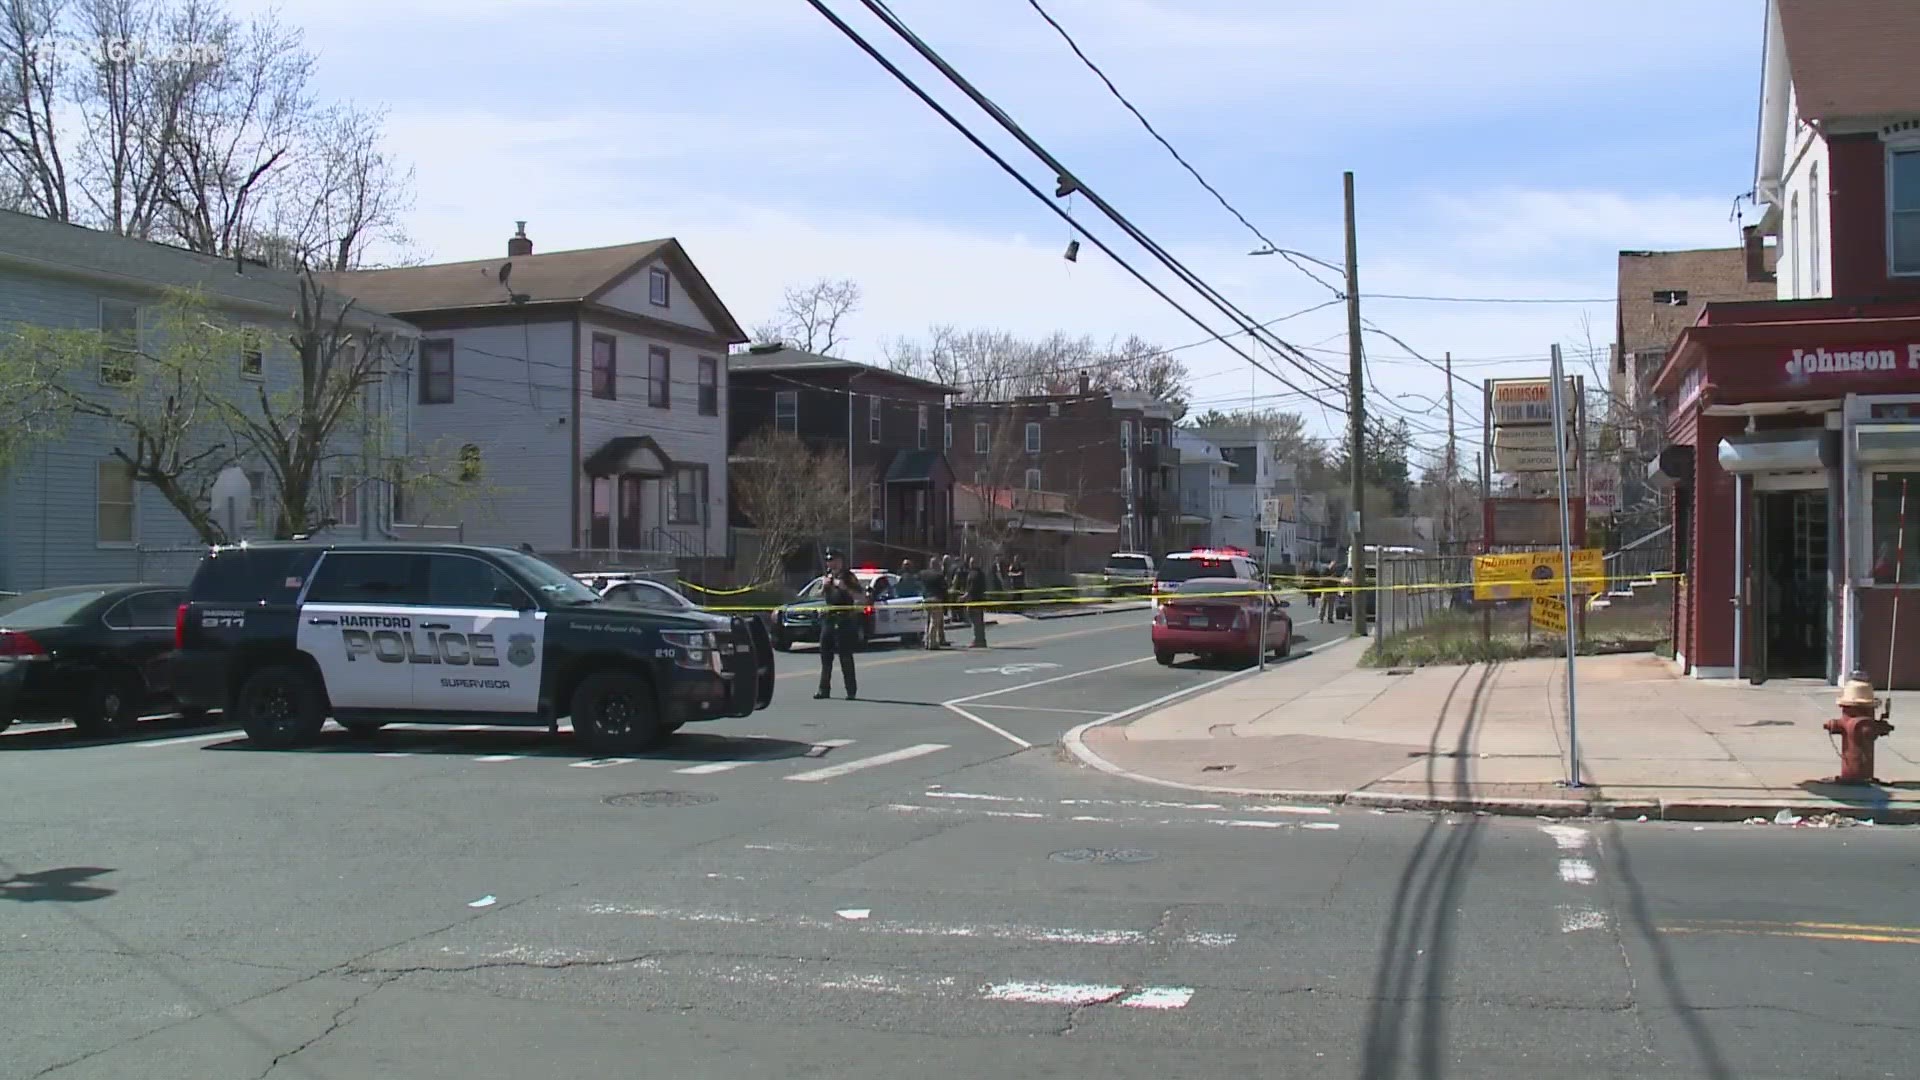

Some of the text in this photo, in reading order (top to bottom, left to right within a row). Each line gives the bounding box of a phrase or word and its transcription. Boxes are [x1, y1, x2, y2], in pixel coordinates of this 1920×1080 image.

[1785, 347, 1896, 375] Johnson
[1497, 385, 1546, 401] JOHNSON
[202, 618, 245, 628] 911
[340, 616, 411, 629] HARTFORD
[342, 630, 499, 667] POLICE
[440, 678, 511, 689] SUPERVISOR
